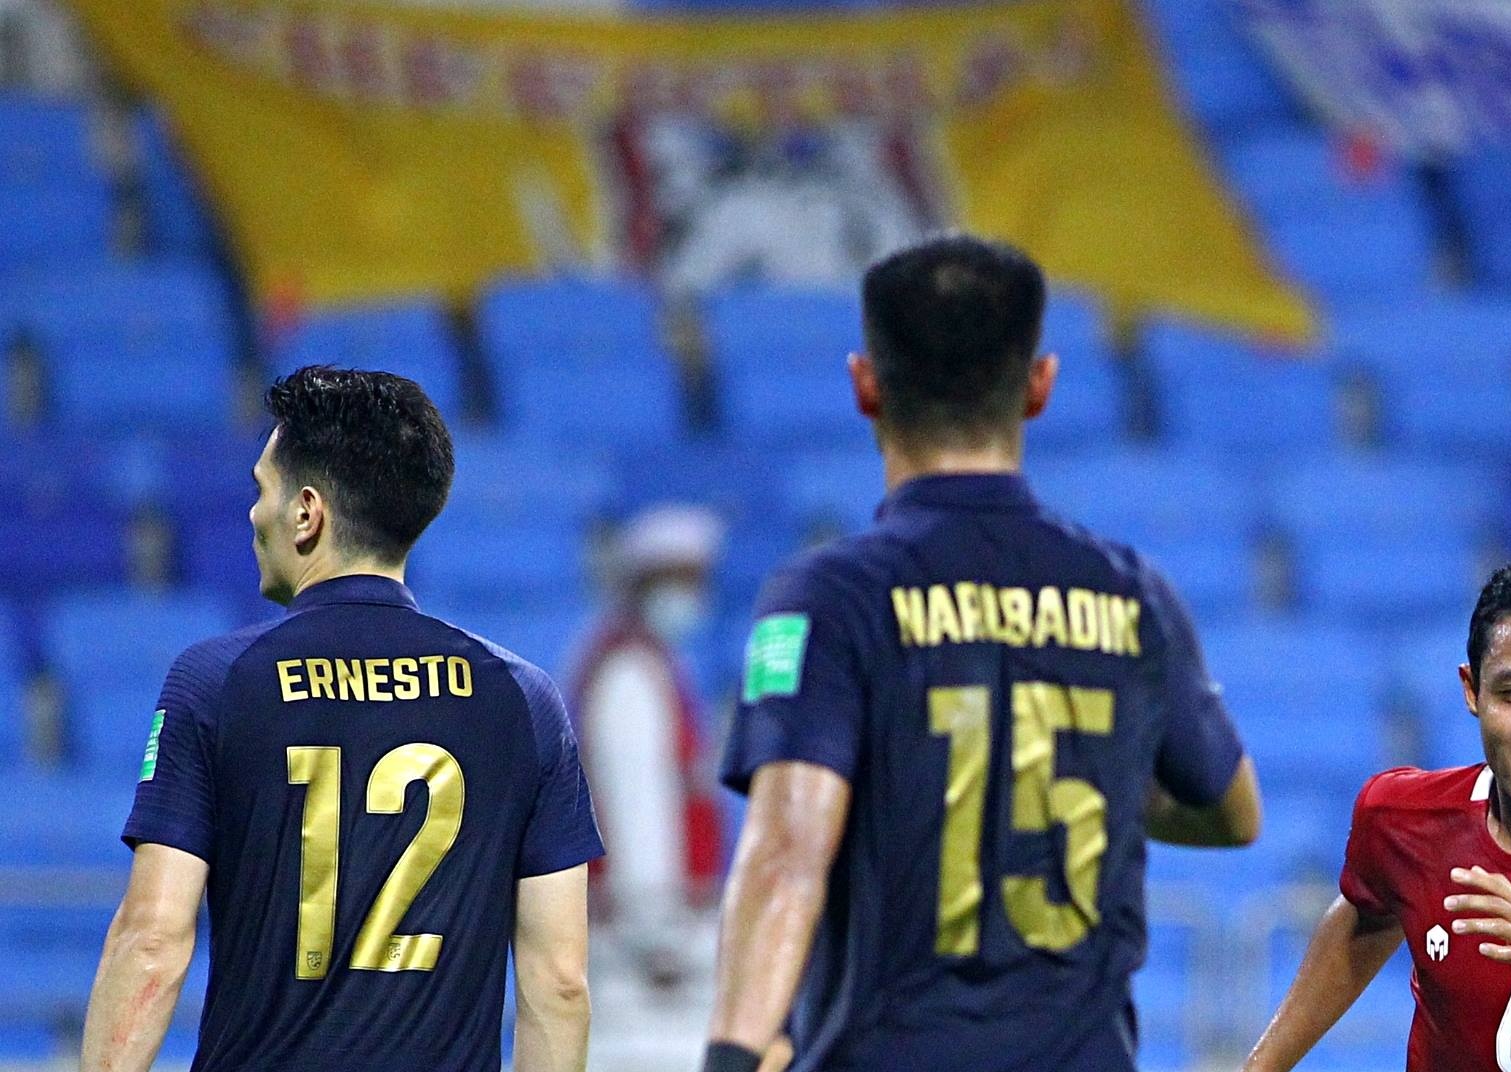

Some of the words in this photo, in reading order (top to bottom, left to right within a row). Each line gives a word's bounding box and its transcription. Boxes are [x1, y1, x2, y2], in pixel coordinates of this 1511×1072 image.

[276, 655, 474, 703] ERNESTO
[286, 742, 466, 981] 12
[927, 680, 1115, 956] 15
